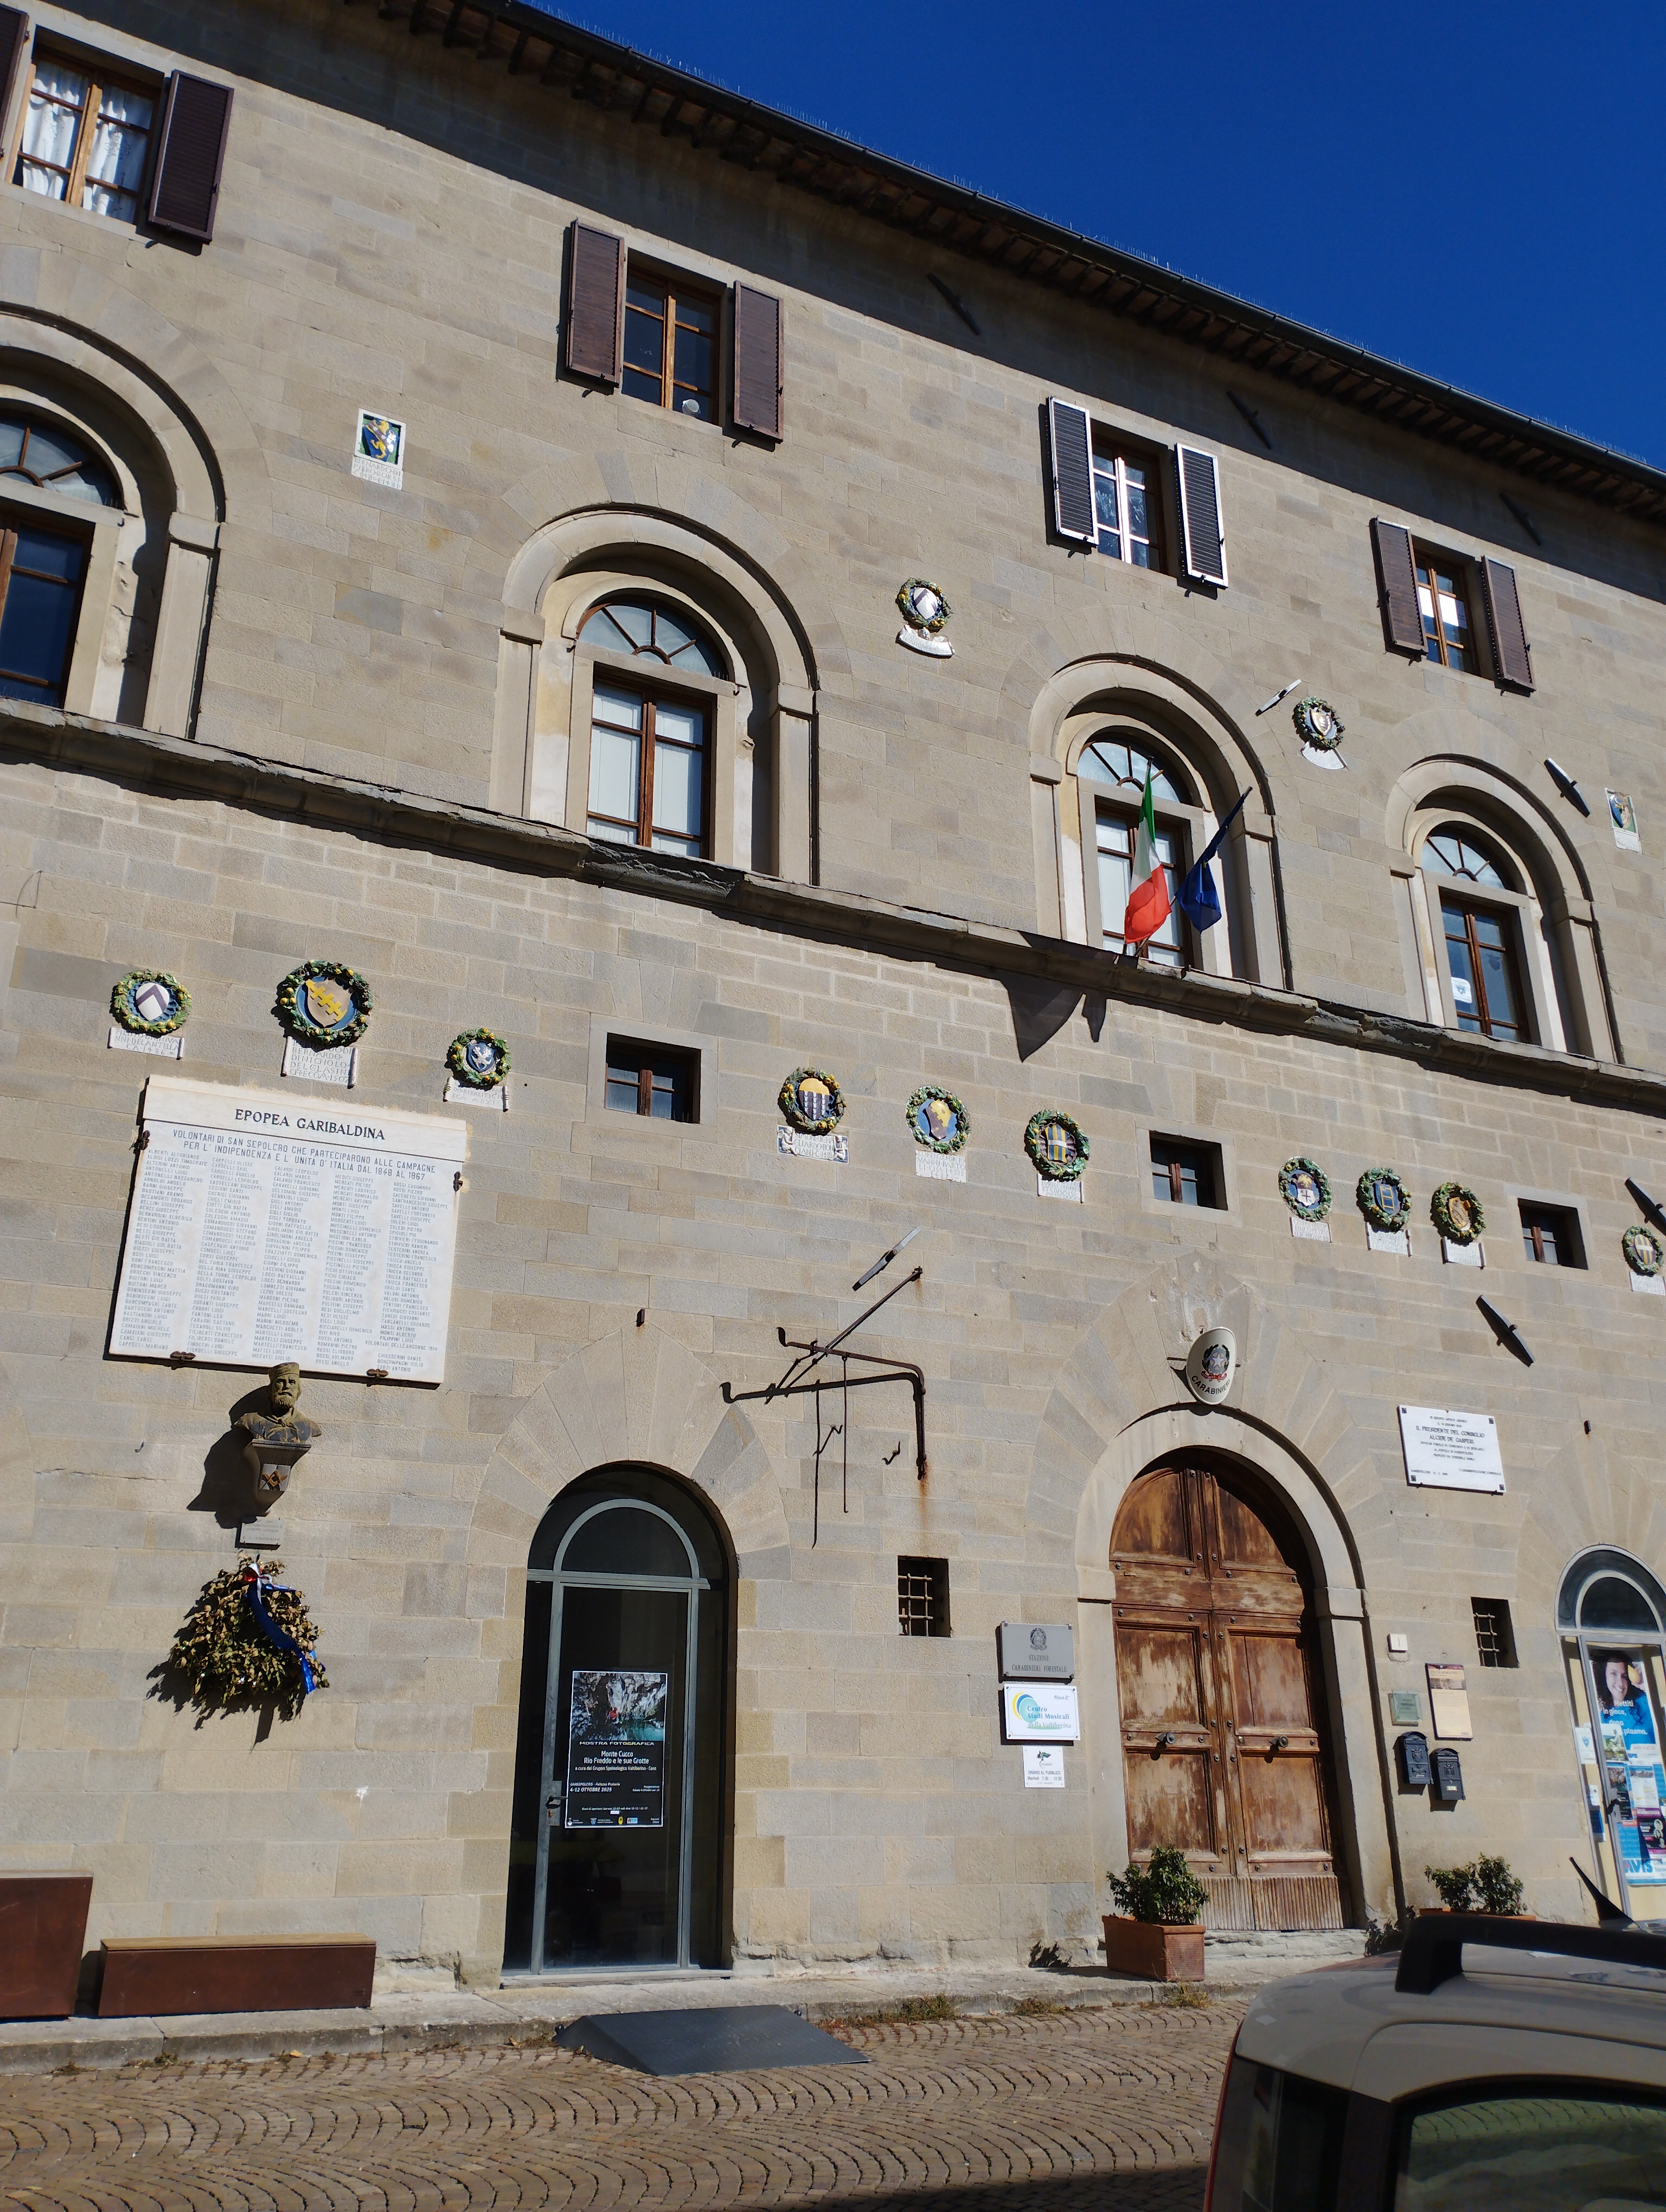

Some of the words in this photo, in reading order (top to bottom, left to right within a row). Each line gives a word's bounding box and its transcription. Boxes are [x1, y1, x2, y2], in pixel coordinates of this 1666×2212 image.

[235, 1109, 290, 1127] EPOPEA
[297, 1118, 386, 1140] GARIBALDINA
[172, 1129, 215, 1142] VOLONTARI
[227, 1137, 243, 1146] SAN
[246, 1140, 288, 1152] SEPOLCRO
[291, 1146, 306, 1154] CHE
[310, 1148, 370, 1163] PARTECIPARONO
[374, 1158, 393, 1167] ALLE
[396, 1161, 435, 1173] CAMPAGNE
[183, 1141, 199, 1150] PER
[214, 1144, 271, 1159] INDIPENDENZA
[275, 1153, 280, 1161] E
[330, 1161, 354, 1171] ITALIA
[357, 1165, 371, 1173] DAL
[396, 1169, 405, 1178] AL
[408, 1172, 425, 1180] 1867
[1191, 1375, 1230, 1394] CARABINIERI
